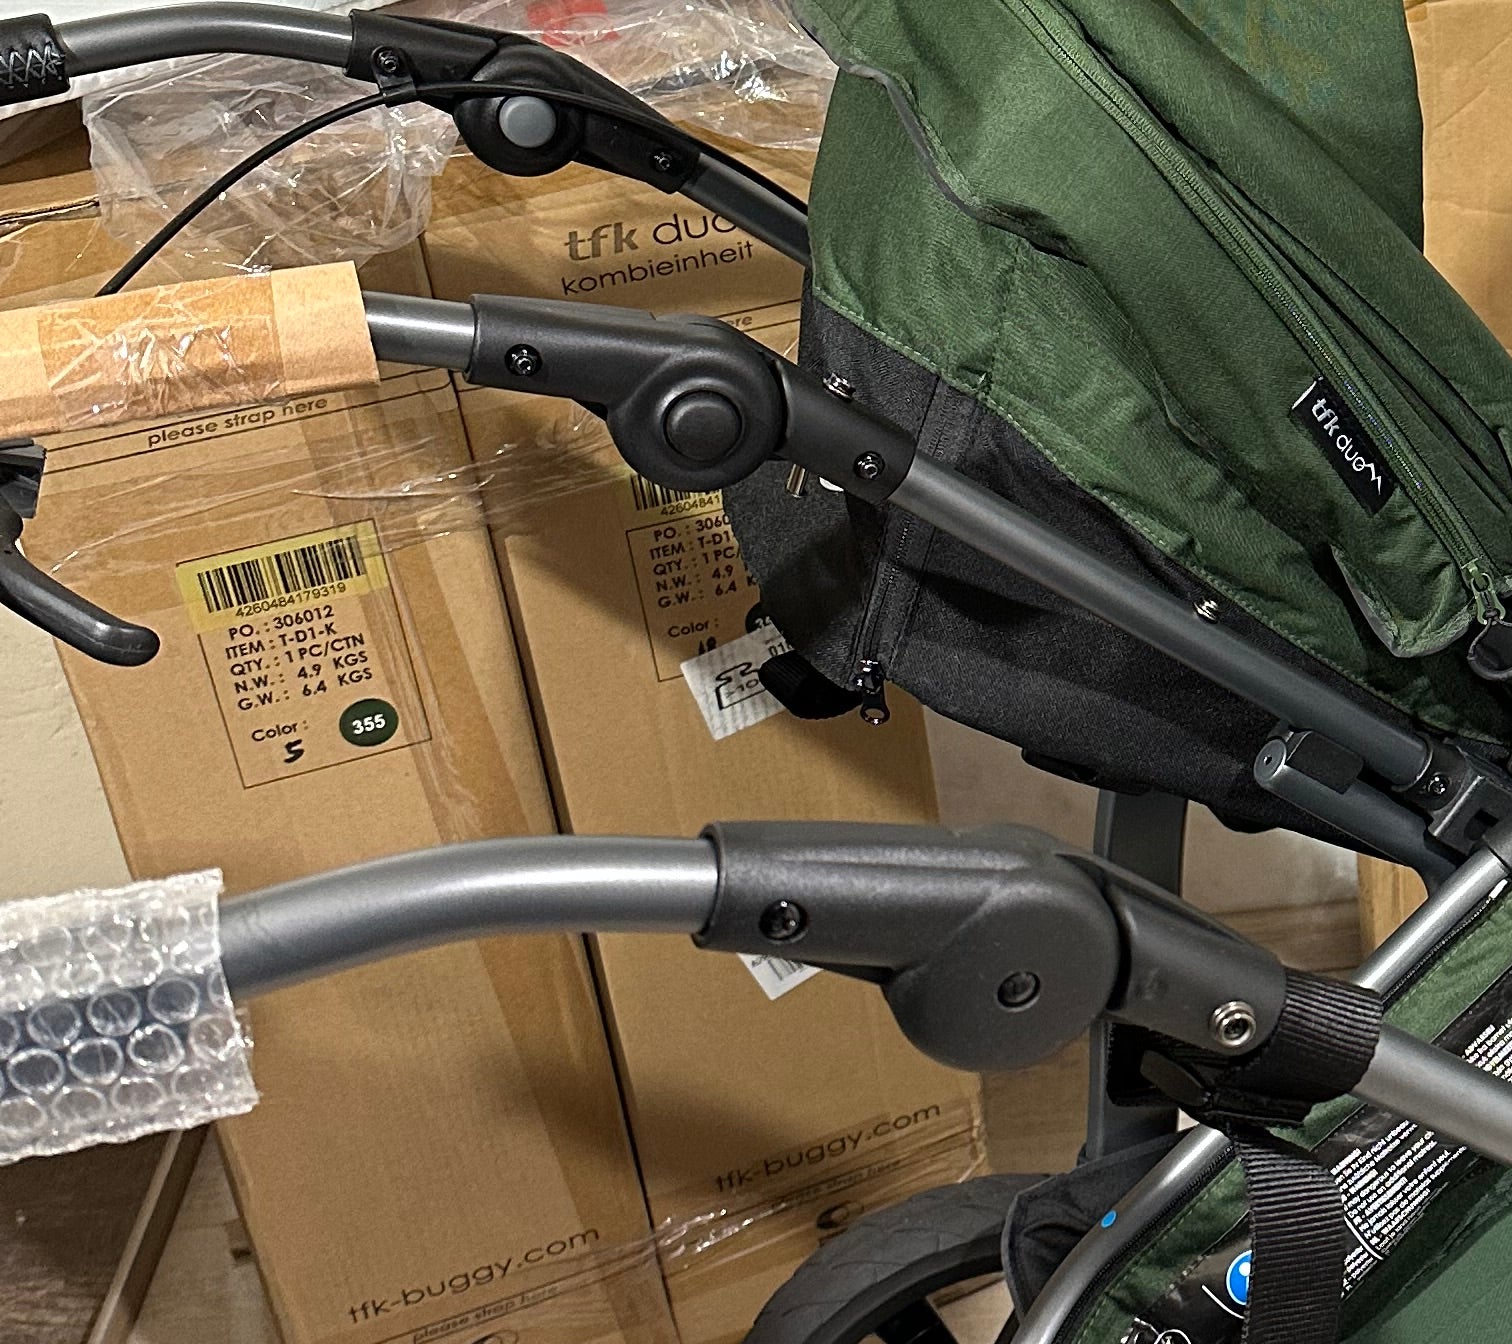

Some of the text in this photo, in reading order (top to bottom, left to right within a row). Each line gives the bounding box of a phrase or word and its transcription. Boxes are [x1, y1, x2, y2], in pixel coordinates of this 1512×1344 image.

[564, 222, 638, 262] tfk
[561, 241, 753, 296] kombieinheit
[148, 420, 218, 447] please
[223, 409, 275, 429] strap
[1311, 397, 1340, 437] tfk
[650, 545, 685, 560] ITEM
[712, 566, 733, 580] 4.9
[236, 582, 346, 618] 4260484179319
[715, 580, 737, 596] 6.4
[273, 605, 335, 630] 306012
[668, 619, 710, 638] Color
[225, 642, 265, 659] ITEM
[278, 622, 338, 646] T-D1-K
[299, 633, 365, 661] PC/CTN
[297, 664, 322, 680] 4.9
[333, 651, 369, 669] KGS
[302, 680, 327, 696] 6.4
[337, 668, 373, 687] KGS
[251, 721, 298, 741] Color
[352, 713, 386, 735] 355
[715, 1104, 941, 1192] tfk-buggy.com
[348, 1228, 599, 1324] tfk-buggy.com
